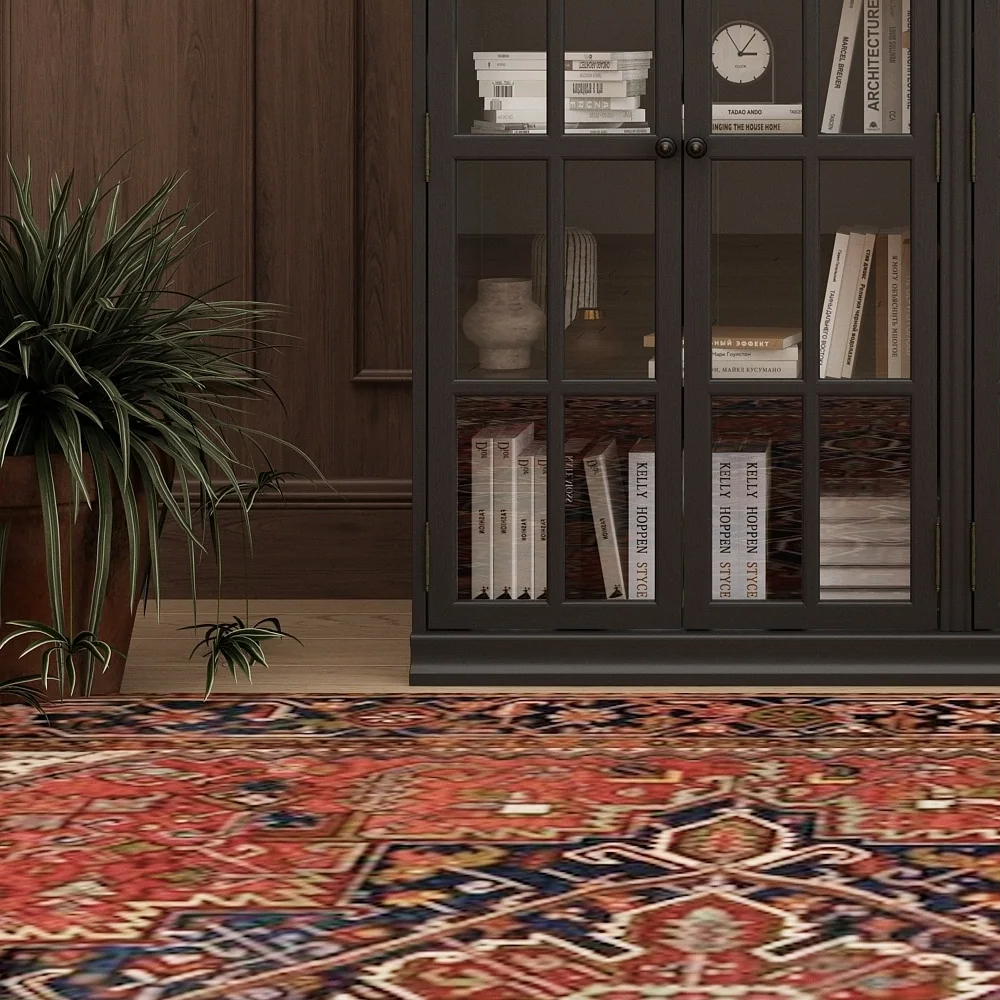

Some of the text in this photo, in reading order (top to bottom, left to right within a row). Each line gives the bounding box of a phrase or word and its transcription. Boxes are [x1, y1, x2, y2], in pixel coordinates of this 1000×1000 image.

[834, 36, 850, 90] MARCEL BREUER
[867, 0, 880, 111] ARCHITECTURE
[733, 123, 745, 131] THE
[745, 123, 764, 131] HOUSE
[764, 123, 781, 131] HOME
[636, 462, 648, 498] KELLY
[719, 462, 731, 498] KELLY
[746, 462, 758, 498] KELLY
[636, 506, 648, 554] HOPPEN
[719, 506, 731, 554] HOPPEN
[746, 506, 758, 554] HOPPEN
